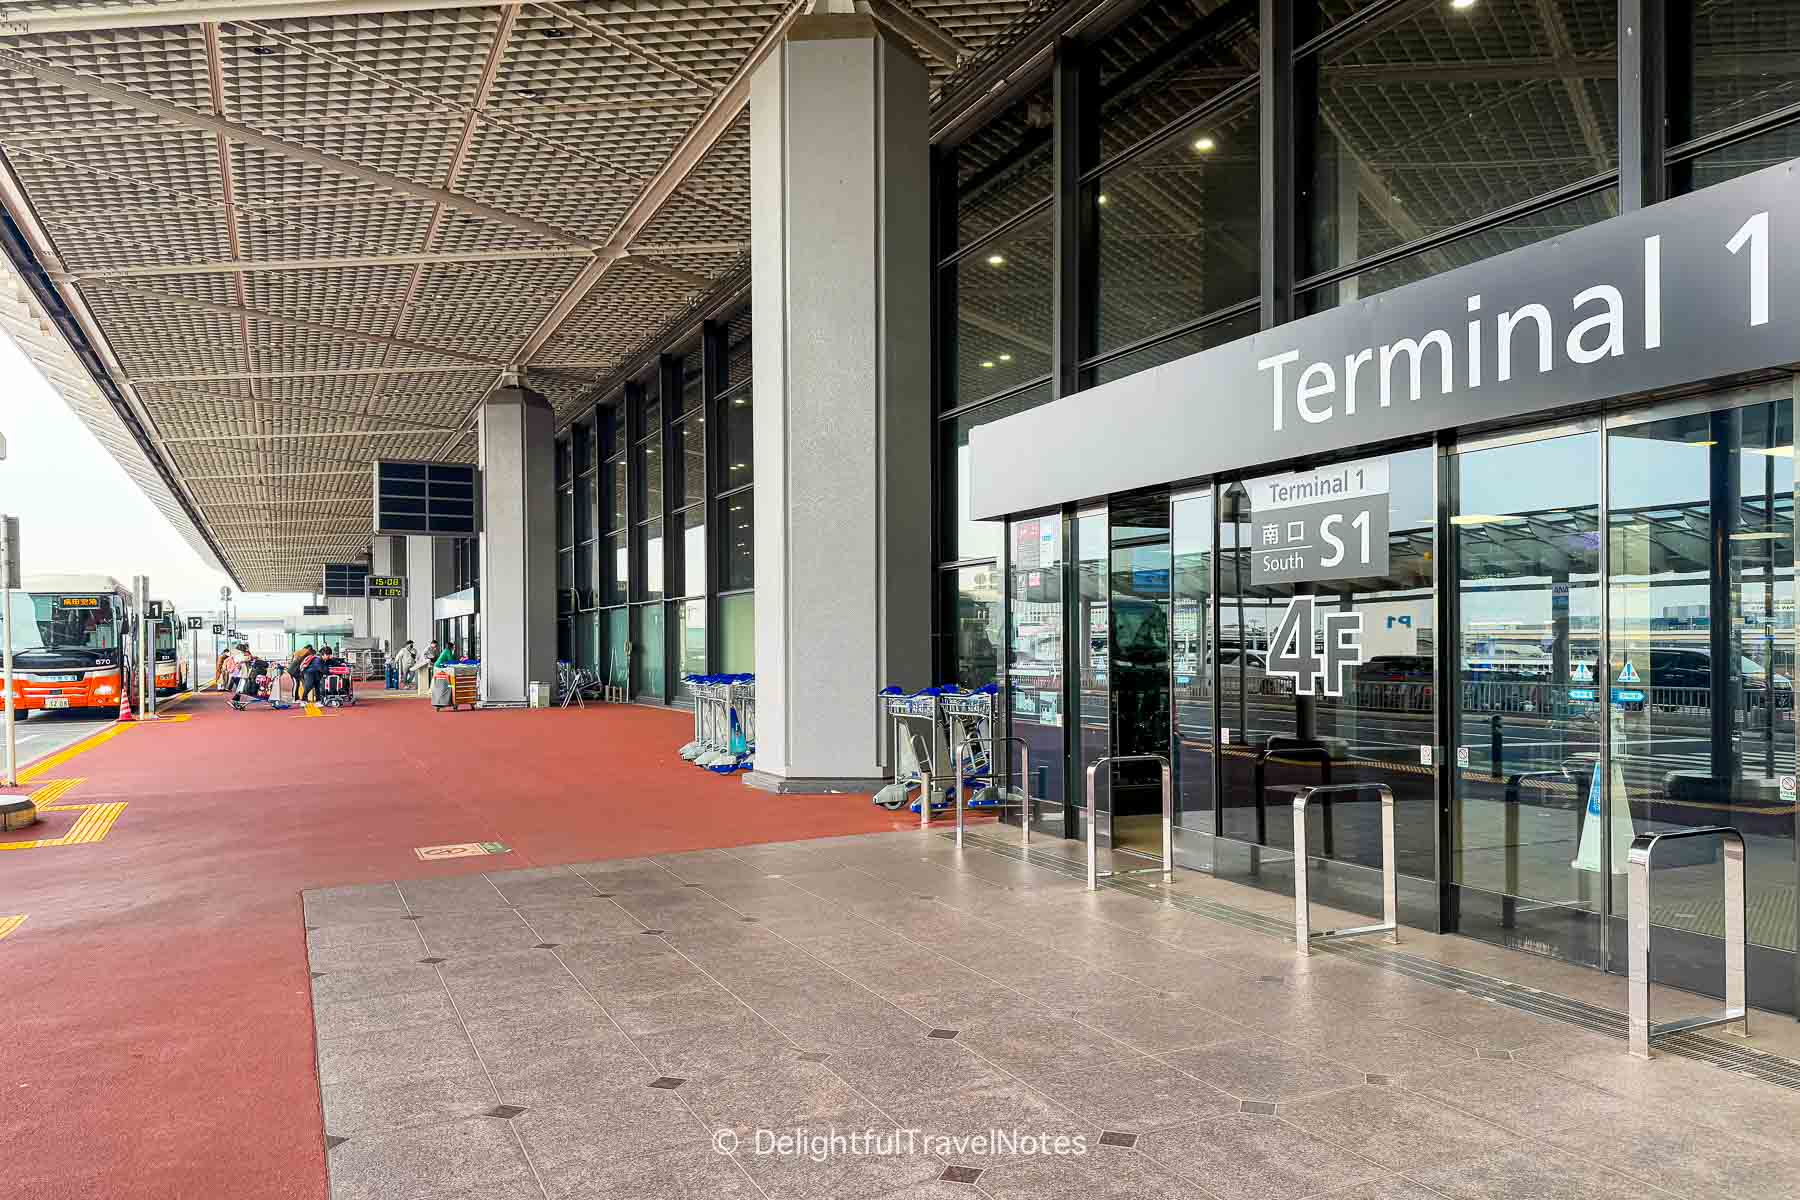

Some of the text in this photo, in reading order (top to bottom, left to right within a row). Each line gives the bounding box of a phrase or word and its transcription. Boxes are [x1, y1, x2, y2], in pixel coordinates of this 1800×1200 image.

[1257, 210, 1769, 432] Terminal 1
[1269, 468, 1364, 504] Terminal 1
[1262, 520, 1305, 545] 南口
[1320, 510, 1370, 568] S1
[1263, 552, 1304, 572] South
[189, 618, 201, 628] 12
[1266, 595, 1364, 697] 4F
